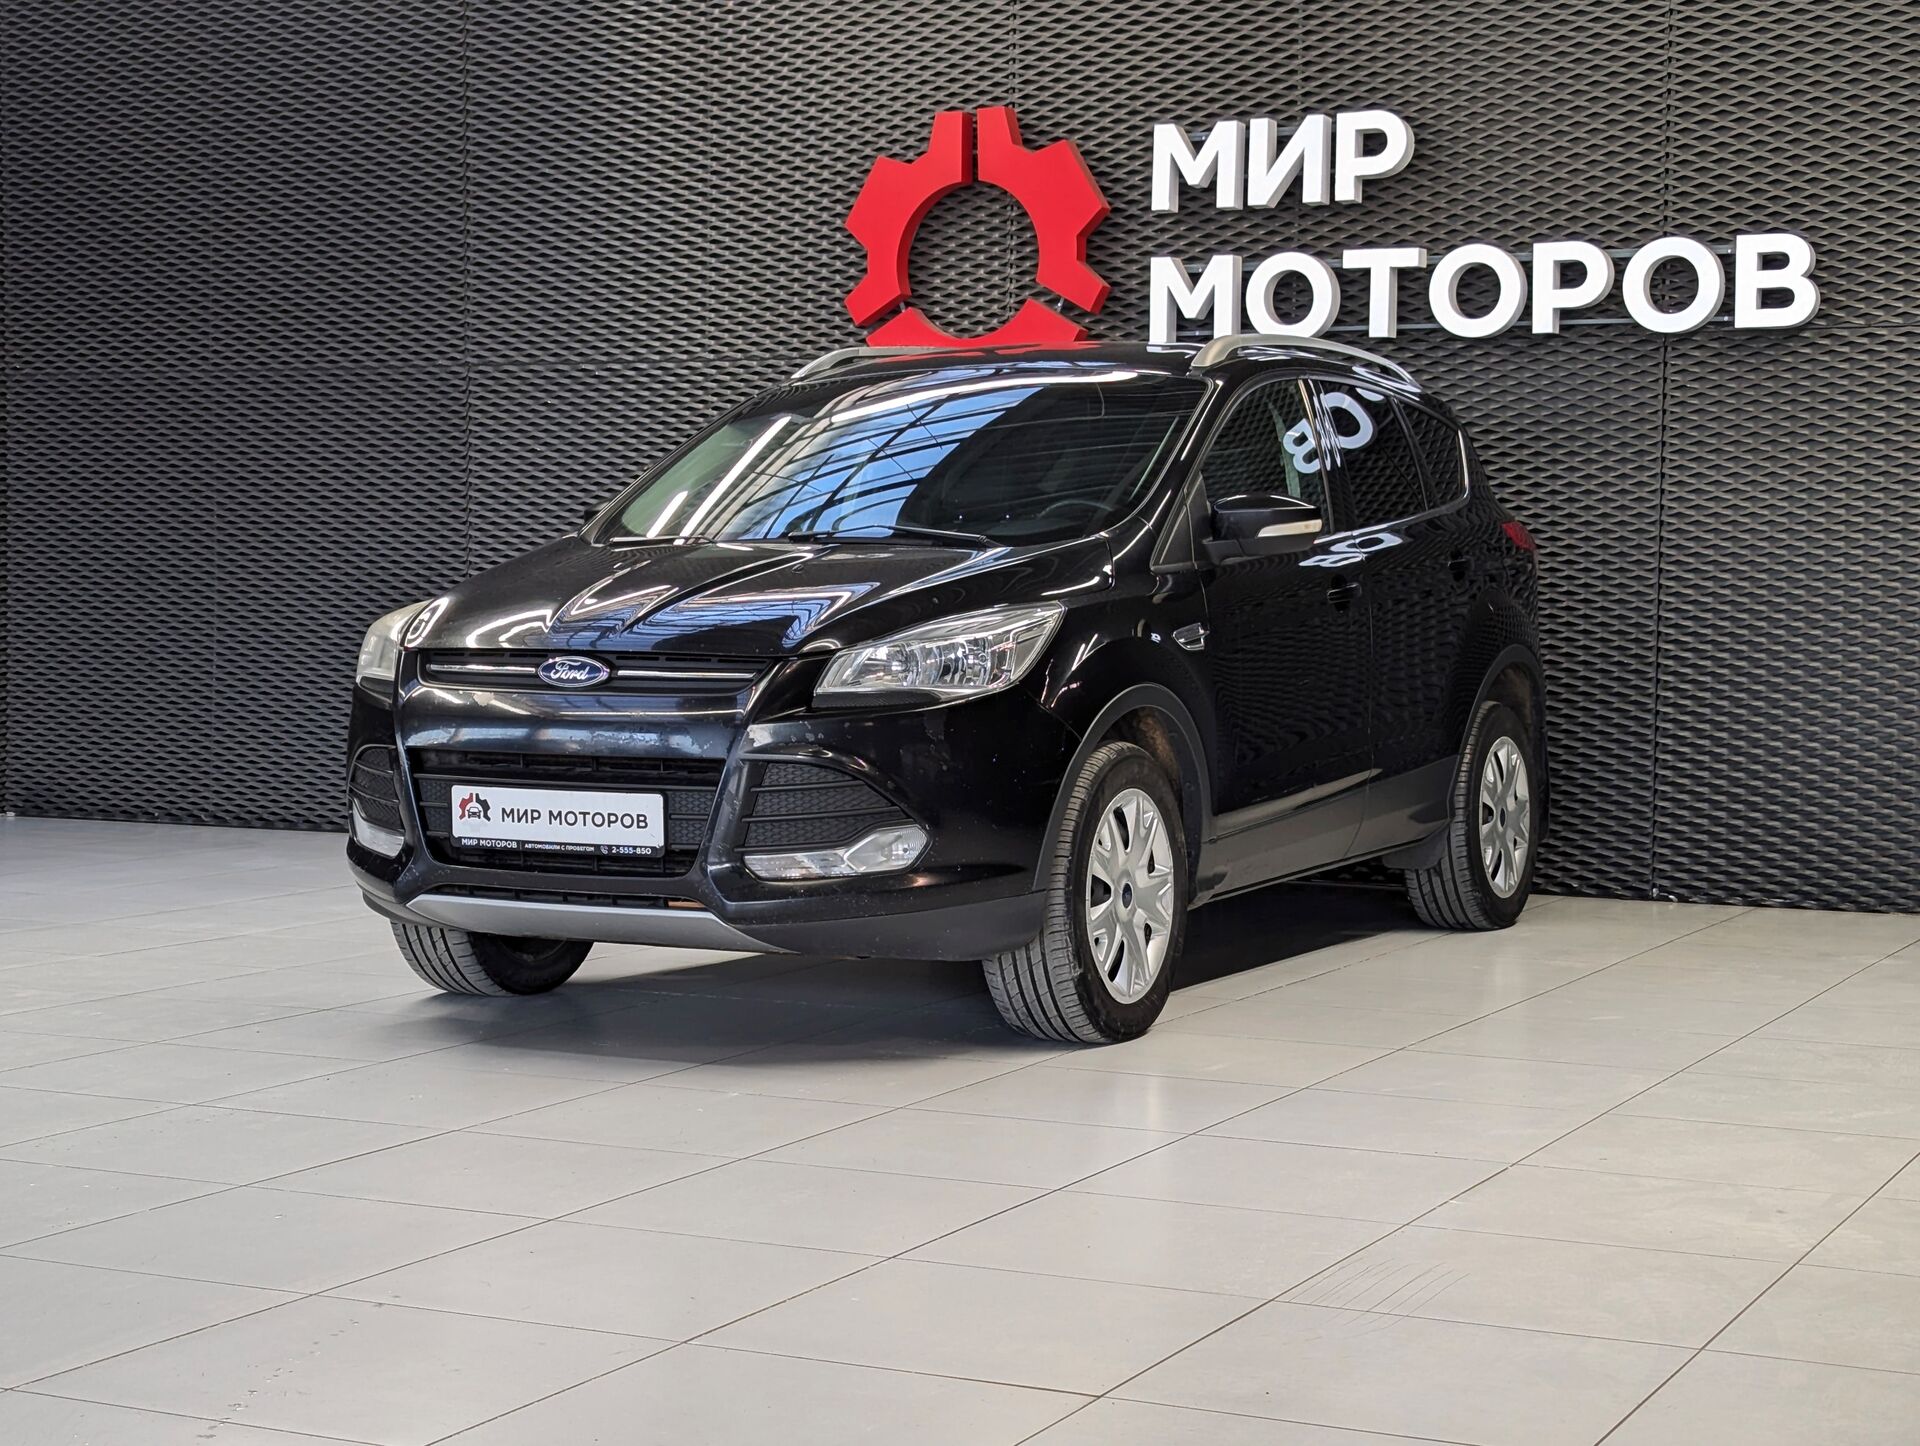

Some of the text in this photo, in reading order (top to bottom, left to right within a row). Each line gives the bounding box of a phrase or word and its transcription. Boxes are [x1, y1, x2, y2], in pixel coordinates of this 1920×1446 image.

[1151, 110, 1415, 211] МИР
[1149, 232, 1820, 344] МОТОРОВ
[550, 660, 590, 680] Ford
[501, 807, 649, 829] МИР МОТОРОВ
[461, 838, 518, 849] МИР МОТОРОВ
[611, 846, 652, 855] 2-555-850
